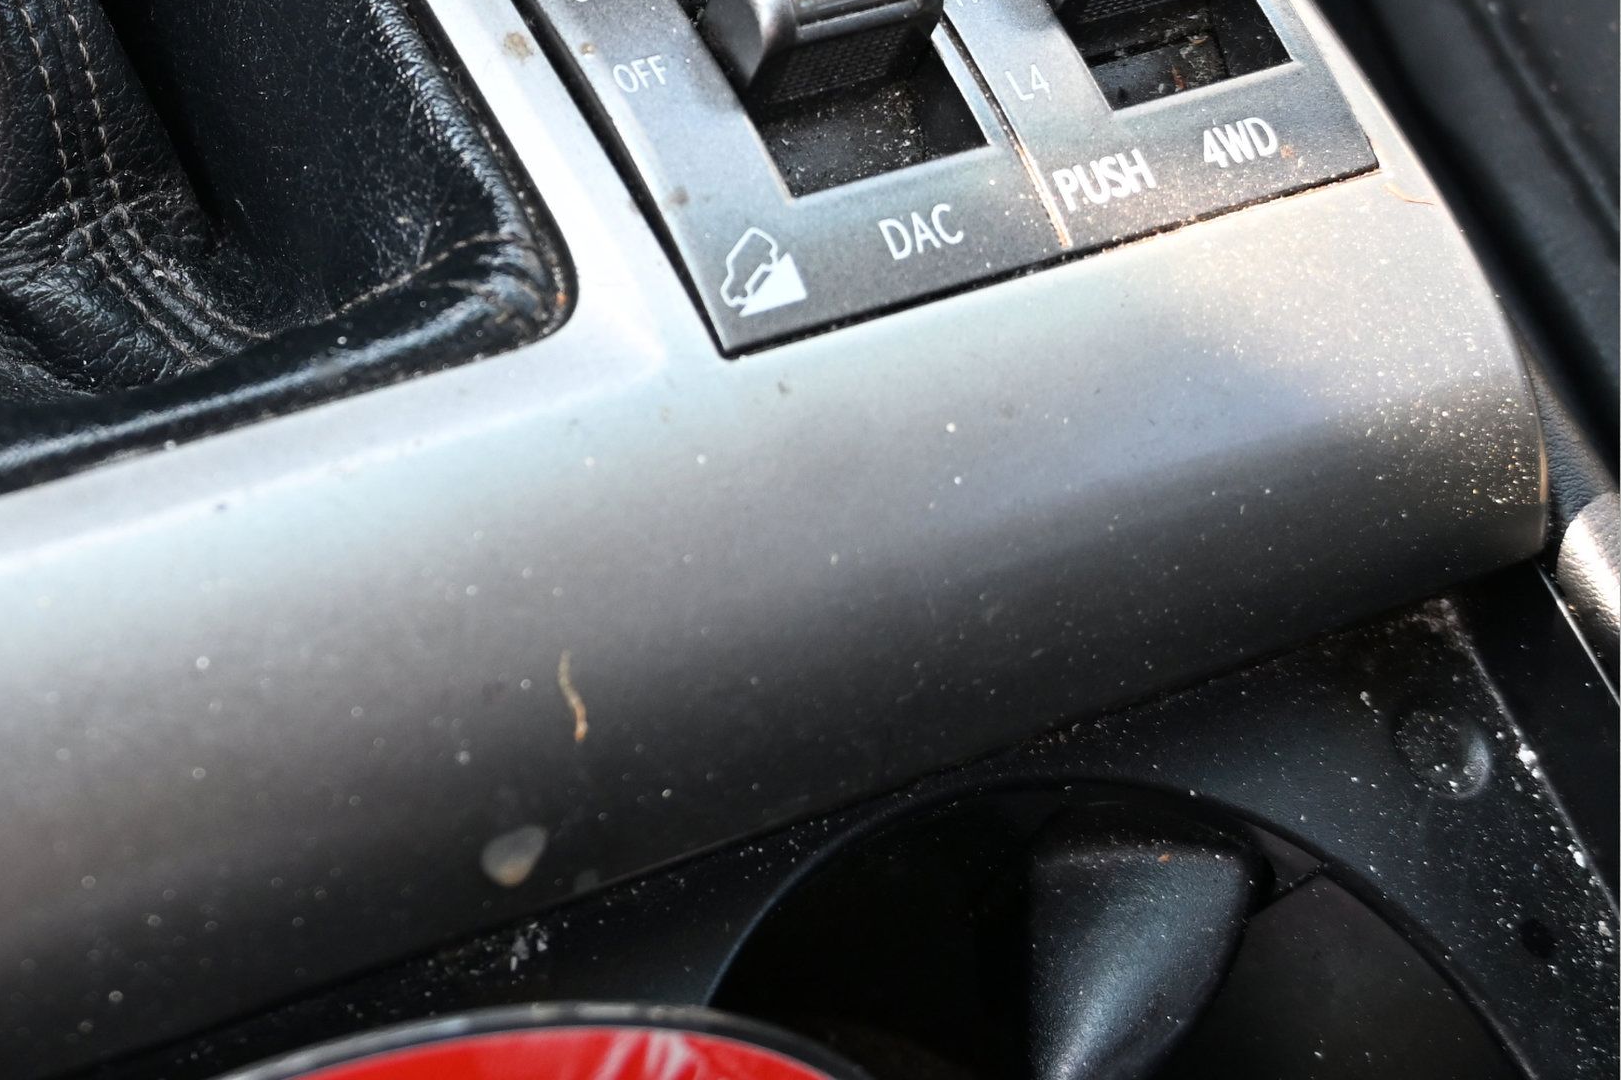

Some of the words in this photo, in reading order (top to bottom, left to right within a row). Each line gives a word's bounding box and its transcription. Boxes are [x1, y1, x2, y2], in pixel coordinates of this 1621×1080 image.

[612, 54, 667, 94] OFF
[1004, 63, 1053, 103] L4
[1203, 117, 1279, 169] 4WD
[1051, 147, 1157, 212] PUSH
[877, 202, 965, 260] DAC
